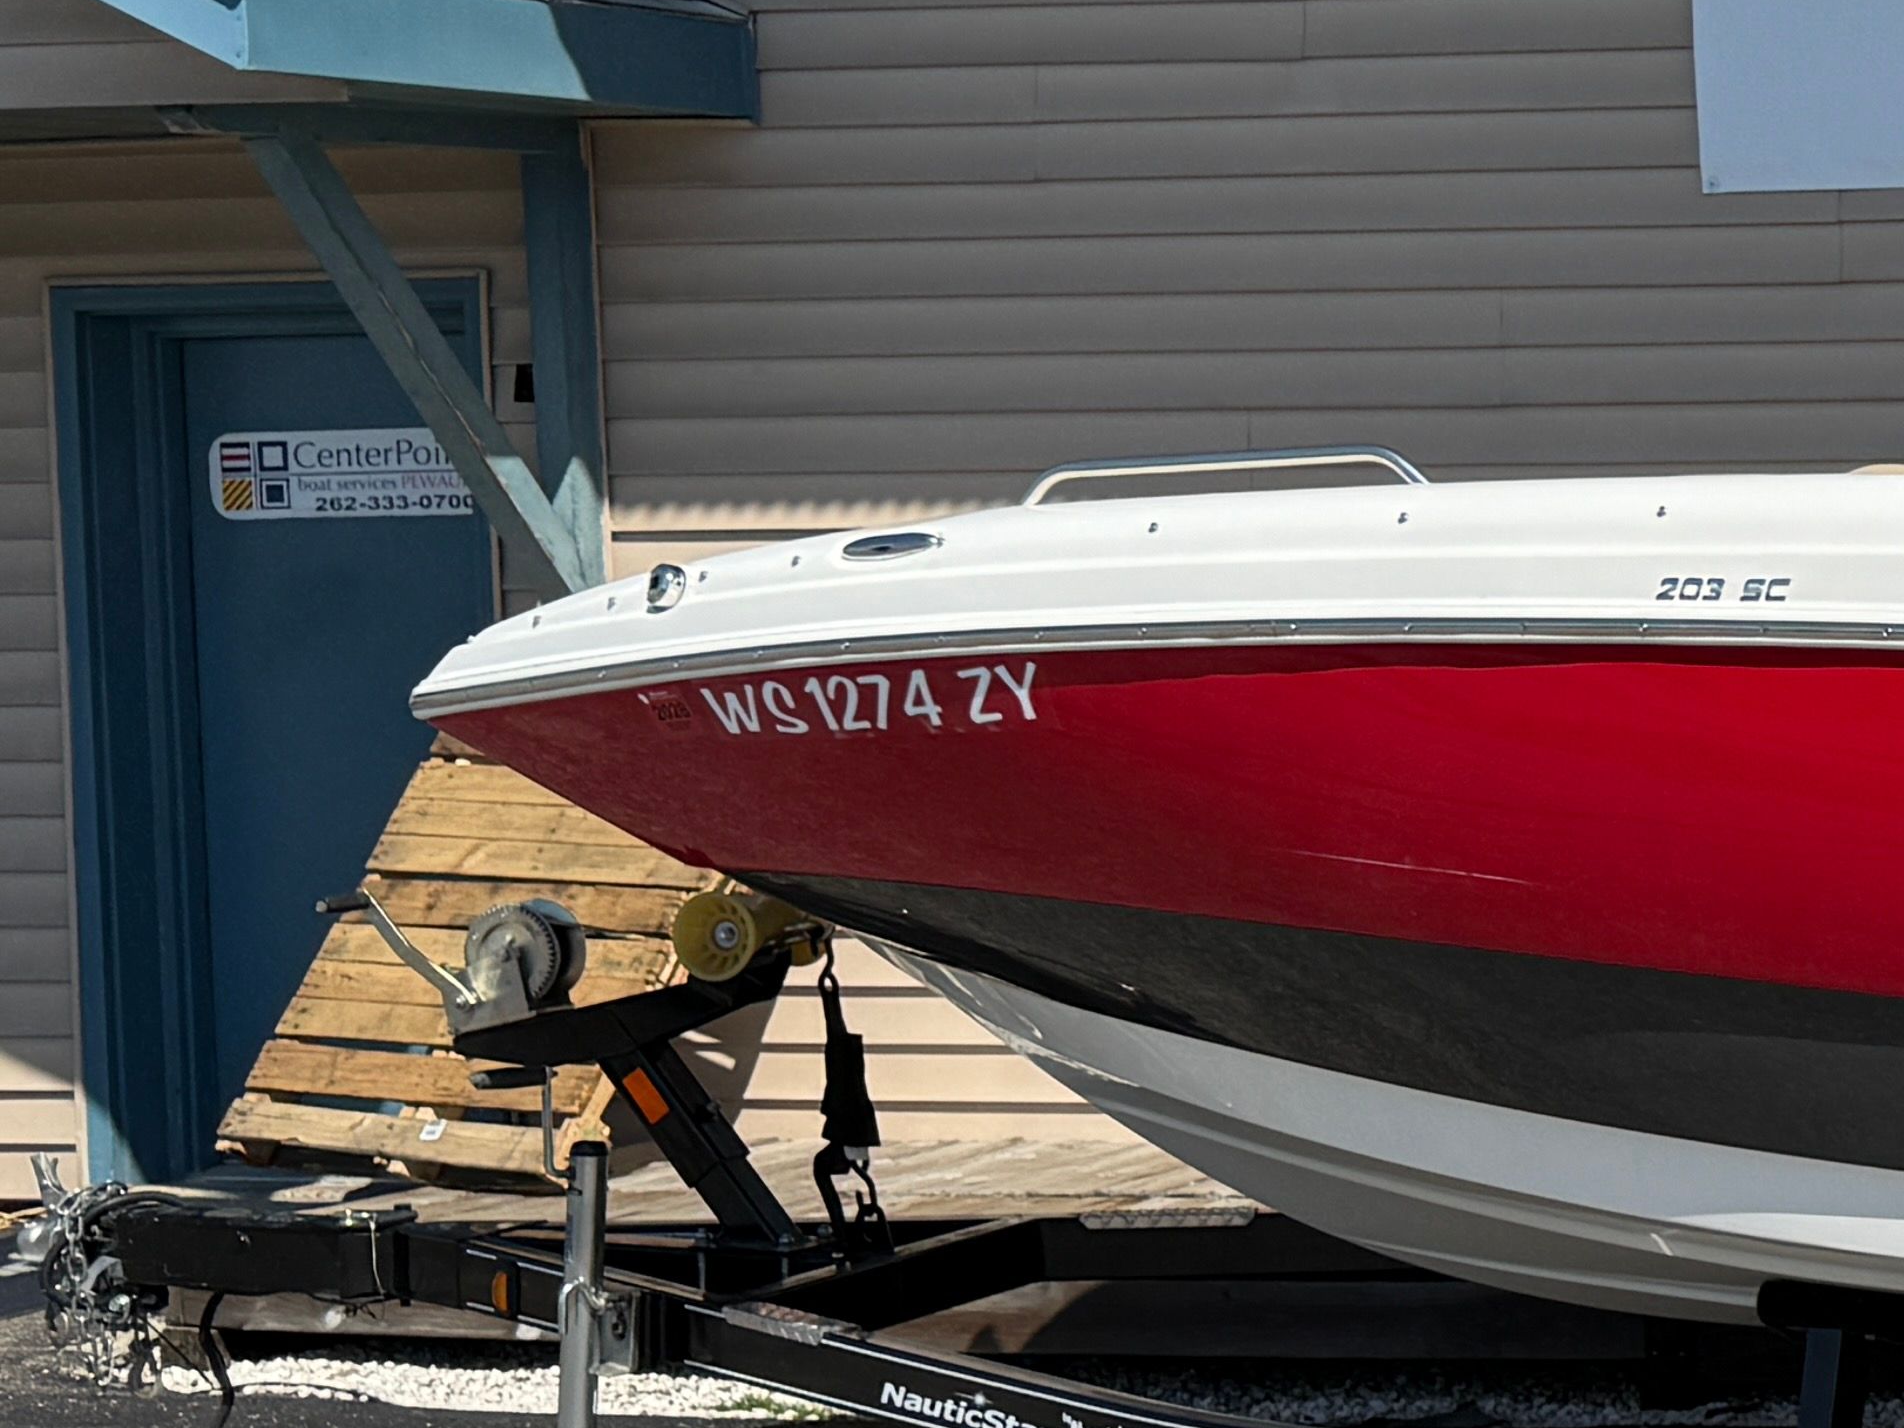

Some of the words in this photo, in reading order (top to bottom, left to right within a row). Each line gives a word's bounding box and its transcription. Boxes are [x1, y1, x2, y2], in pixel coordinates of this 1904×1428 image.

[298, 477, 332, 493] boat
[337, 475, 397, 491] services
[1655, 577, 1725, 601] 203
[1739, 578, 1792, 602] SC
[957, 662, 1038, 724] ZY
